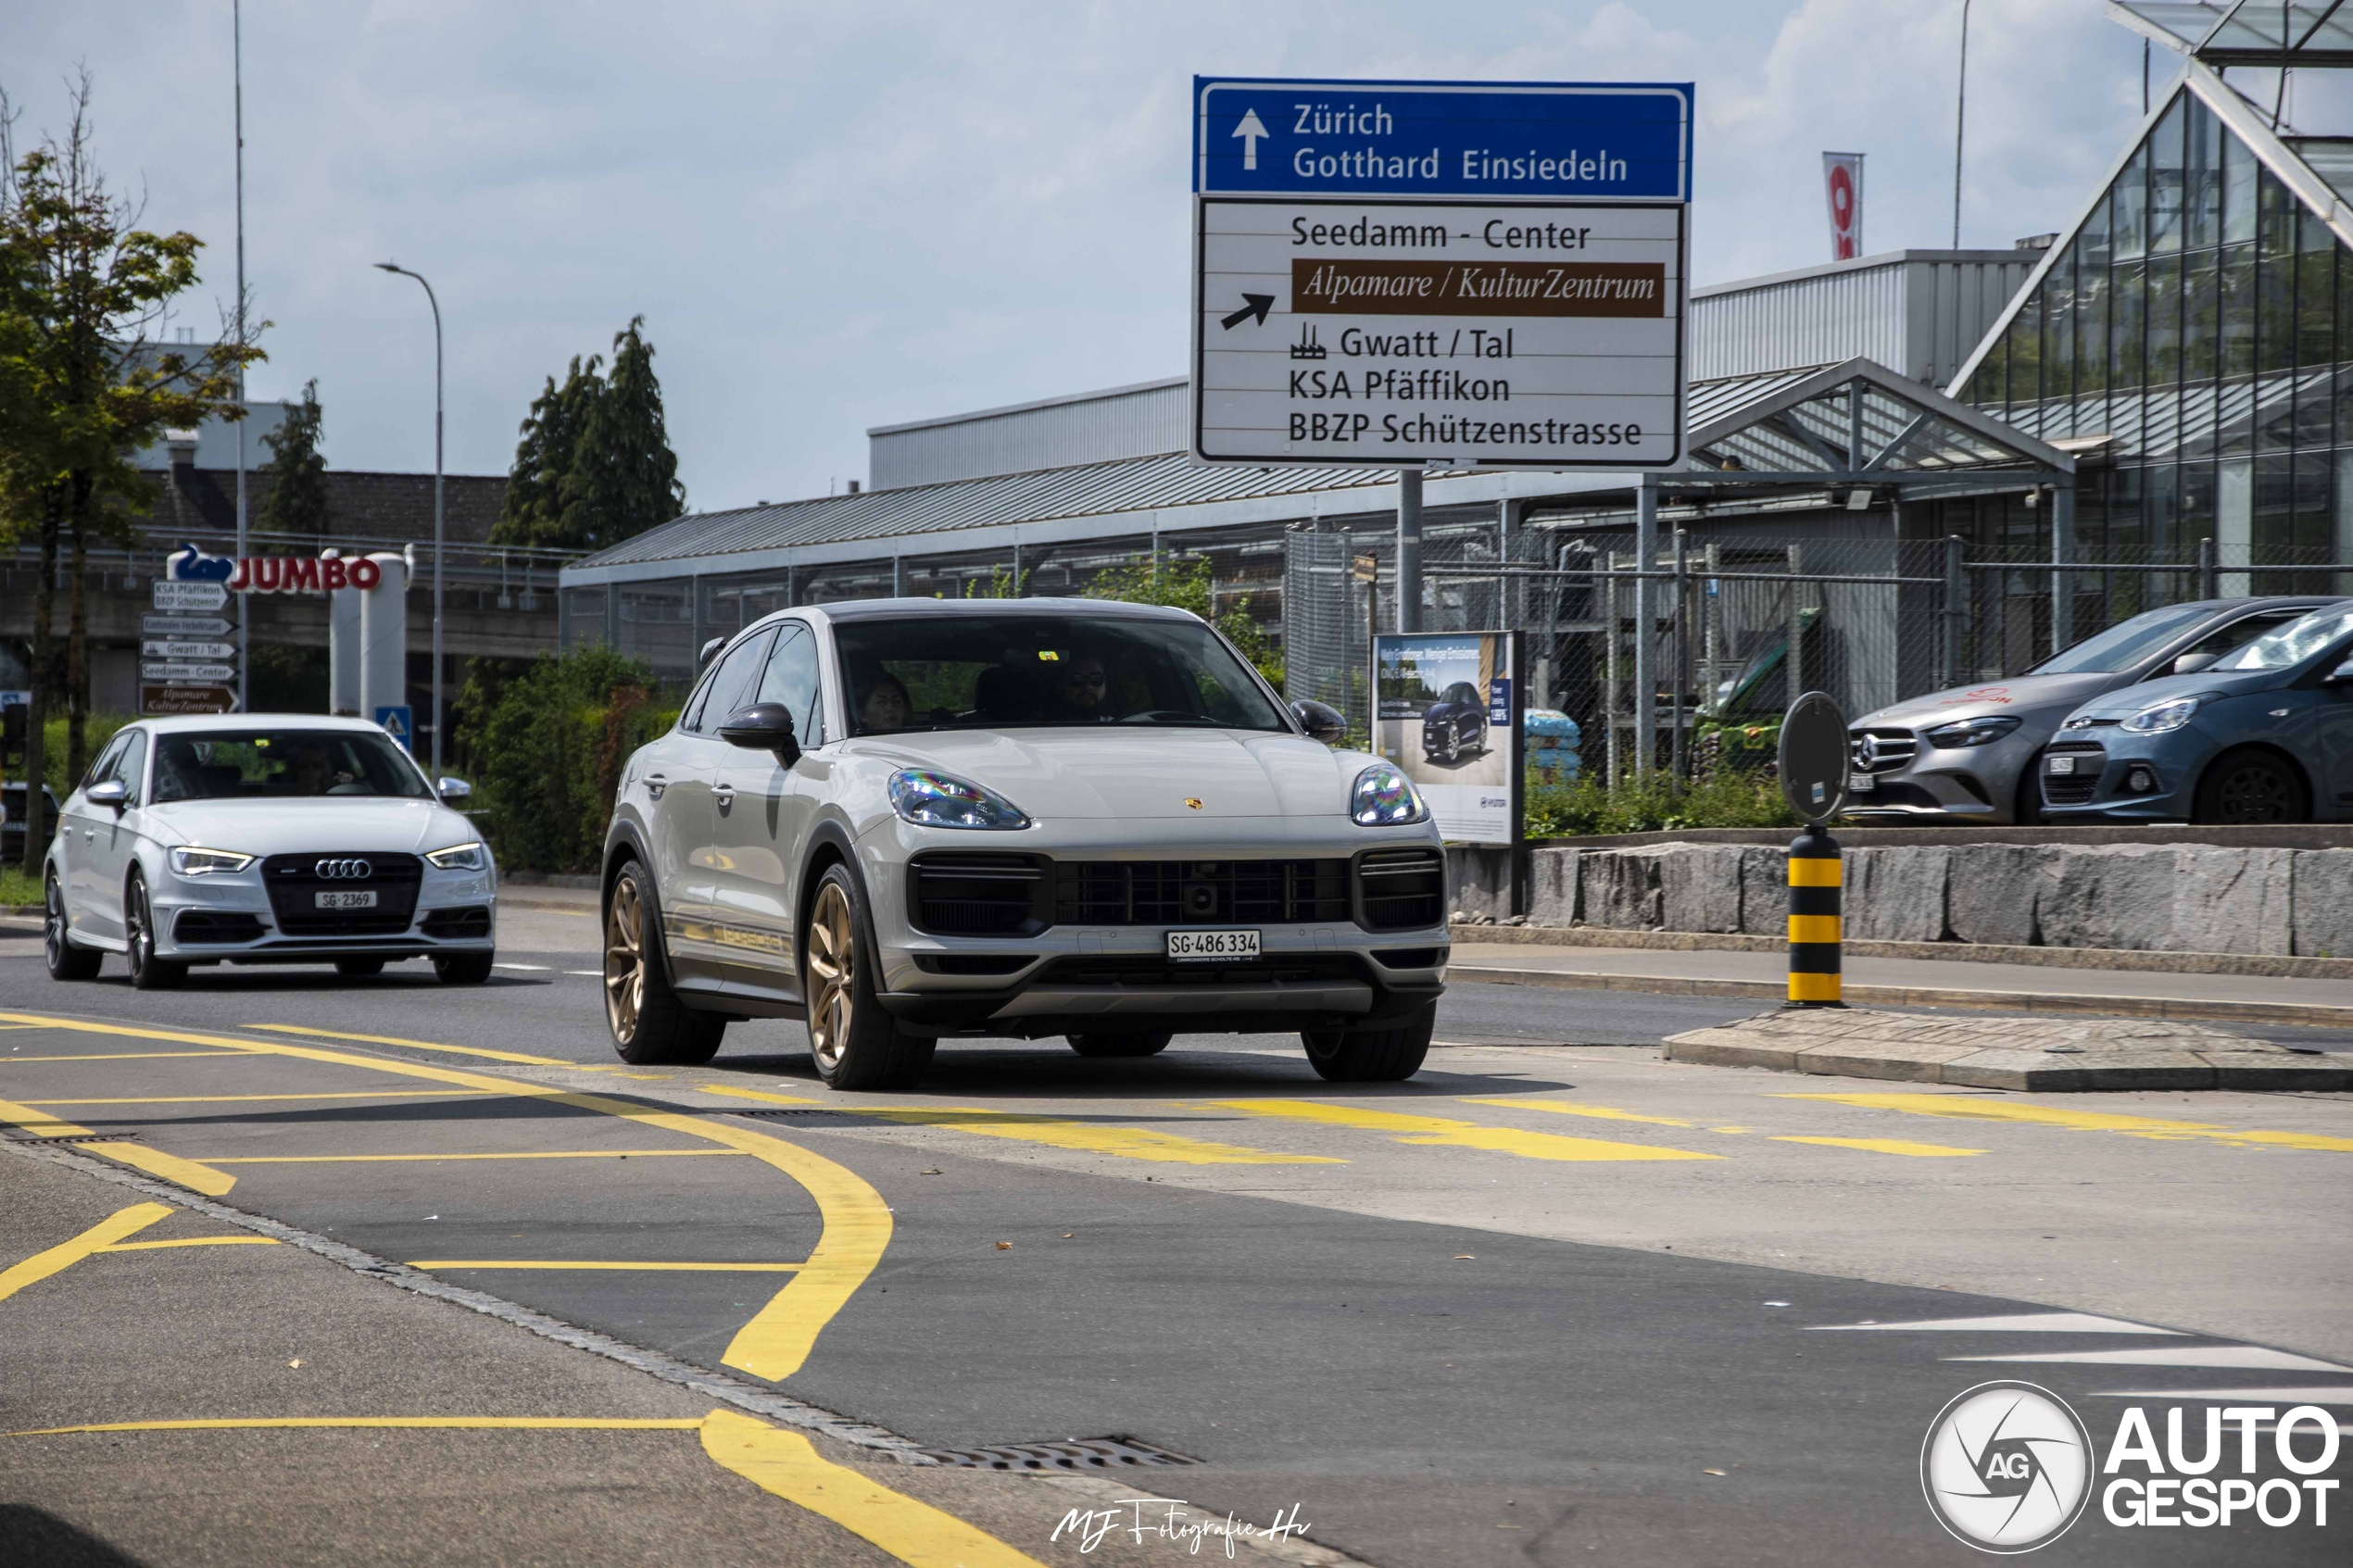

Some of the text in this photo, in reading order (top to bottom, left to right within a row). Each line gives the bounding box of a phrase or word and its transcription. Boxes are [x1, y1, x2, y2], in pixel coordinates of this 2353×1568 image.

[1293, 104, 1392, 135] Zürich
[1293, 146, 1627, 181] Gotthard Einsiedeln
[1291, 216, 1447, 247] Seedamm
[1483, 219, 1591, 249] Center
[1302, 264, 1655, 305] Alpamare / KulturZentrum
[1340, 328, 1515, 358] Gwatt / Tal
[1290, 370, 1510, 401] KSA Pfäffikon
[1290, 413, 1642, 445] BBZP Schützenstrasse
[156, 583, 220, 596] KSA Pfäffikon
[230, 557, 382, 591] JUMBO
[167, 643, 197, 655] Gwatt
[207, 644, 220, 656] Tal
[146, 699, 223, 712] KulturZentrum
[159, 688, 210, 701] Alpamare
[1227, 934, 1257, 952] 334
